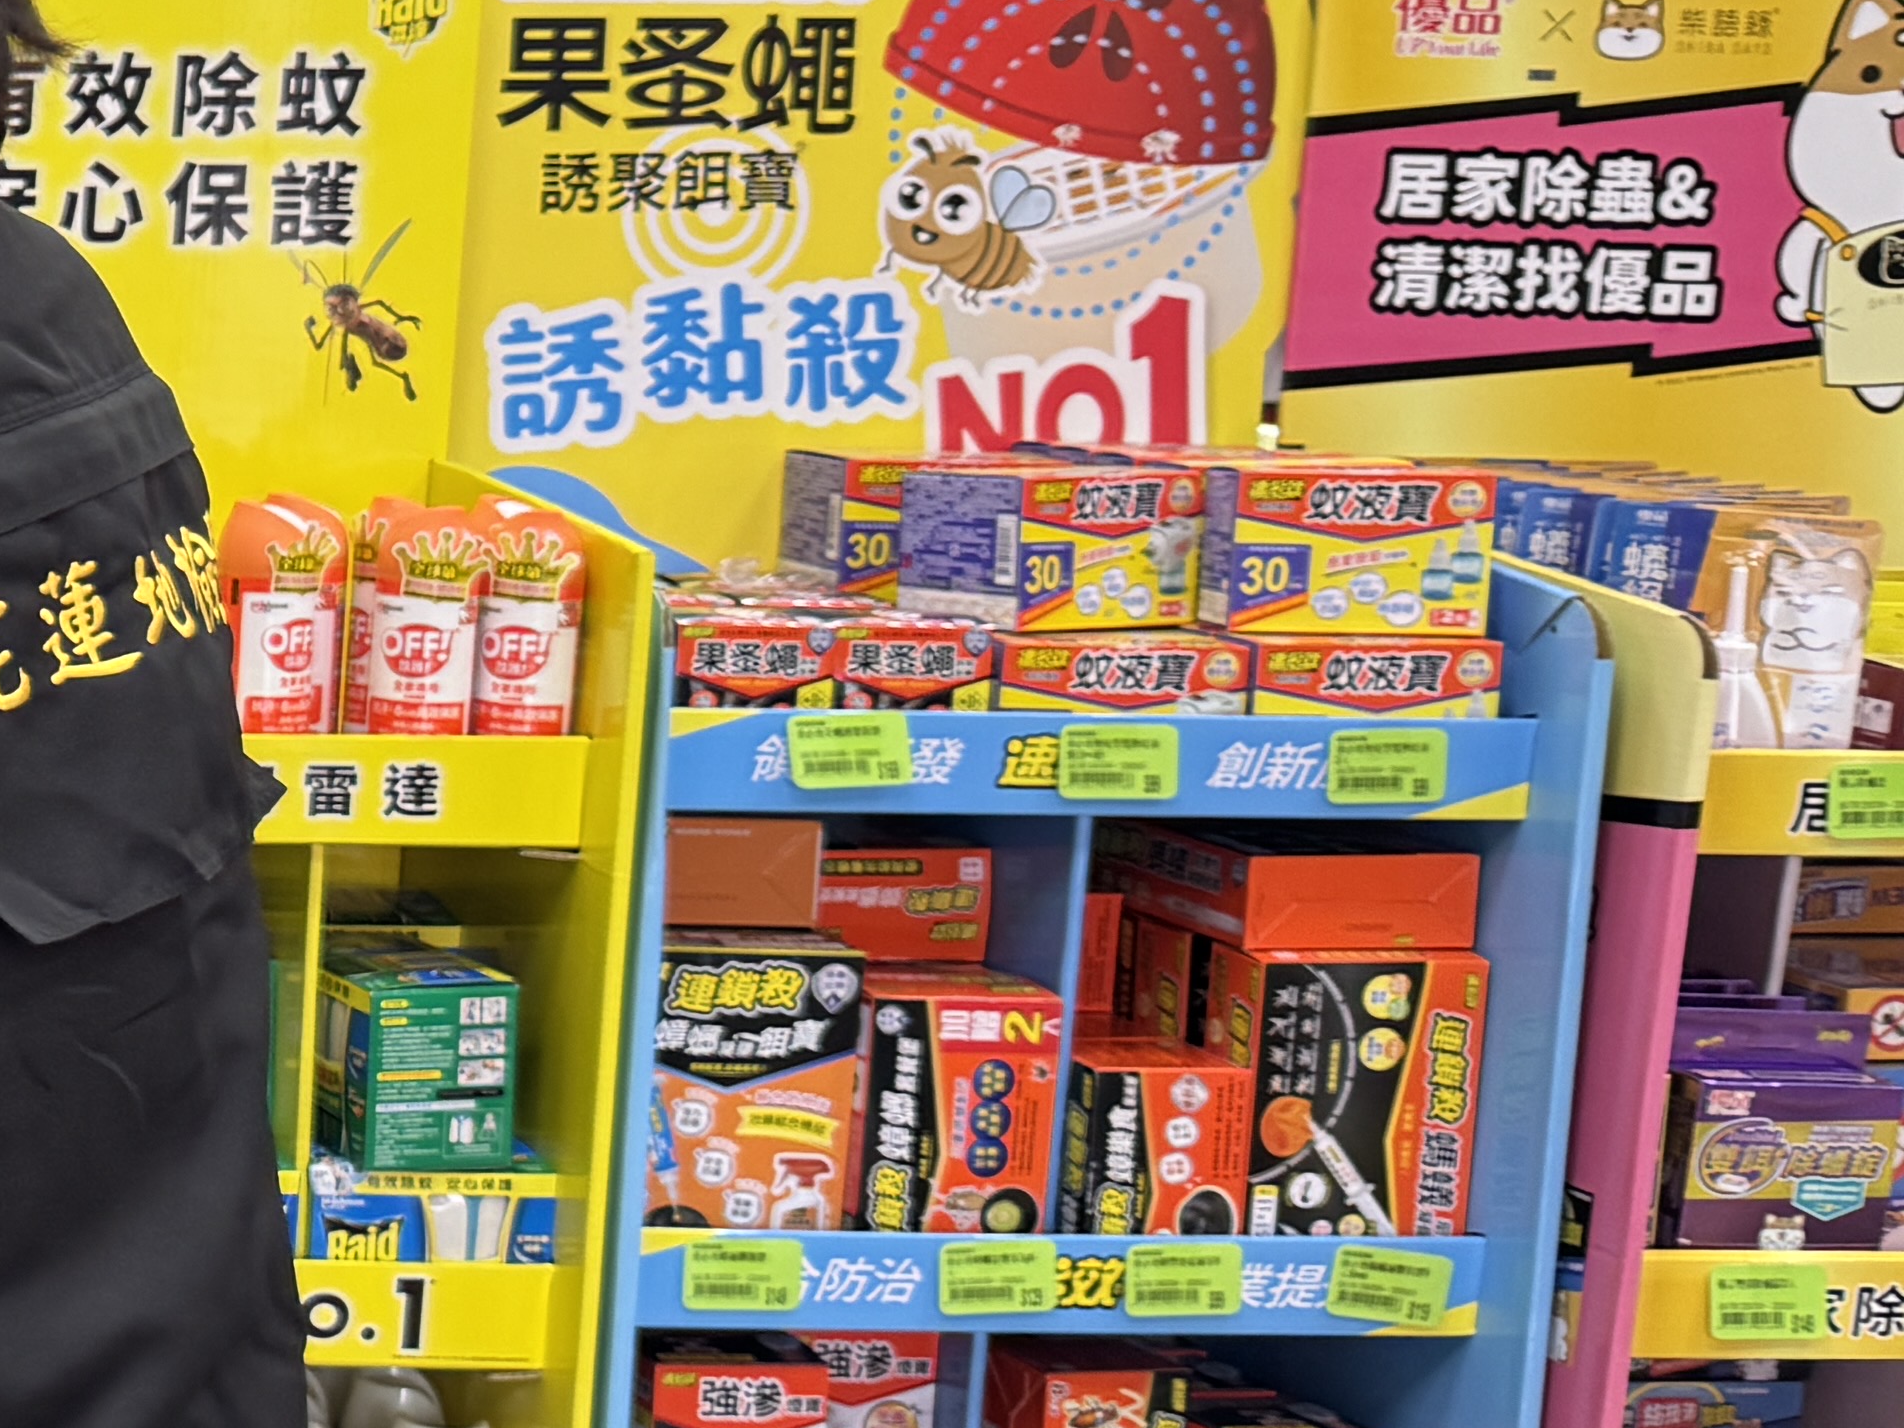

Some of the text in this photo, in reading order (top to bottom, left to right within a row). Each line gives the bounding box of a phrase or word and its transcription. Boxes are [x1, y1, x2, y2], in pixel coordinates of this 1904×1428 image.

[498, 16, 857, 133] 果蚤蠅
[540, 151, 797, 216] 誘聚餌寶
[1379, 152, 1714, 224] 居家除蟲&
[1373, 244, 1719, 316] 清潔找優品
[500, 282, 907, 439] 誘黏殺
[1074, 478, 1162, 521] 蚊液寶
[1306, 479, 1437, 523] 蚊液寶
[845, 534, 890, 568] 30
[1025, 555, 1060, 594] 30
[1239, 556, 1290, 595] 30
[382, 626, 452, 663] OFF!
[482, 628, 552, 665] OFF!
[1072, 653, 1195, 692] 蚊液寶
[1321, 653, 1448, 693] 蚊液寶
[328, 1222, 399, 1261] Raid
